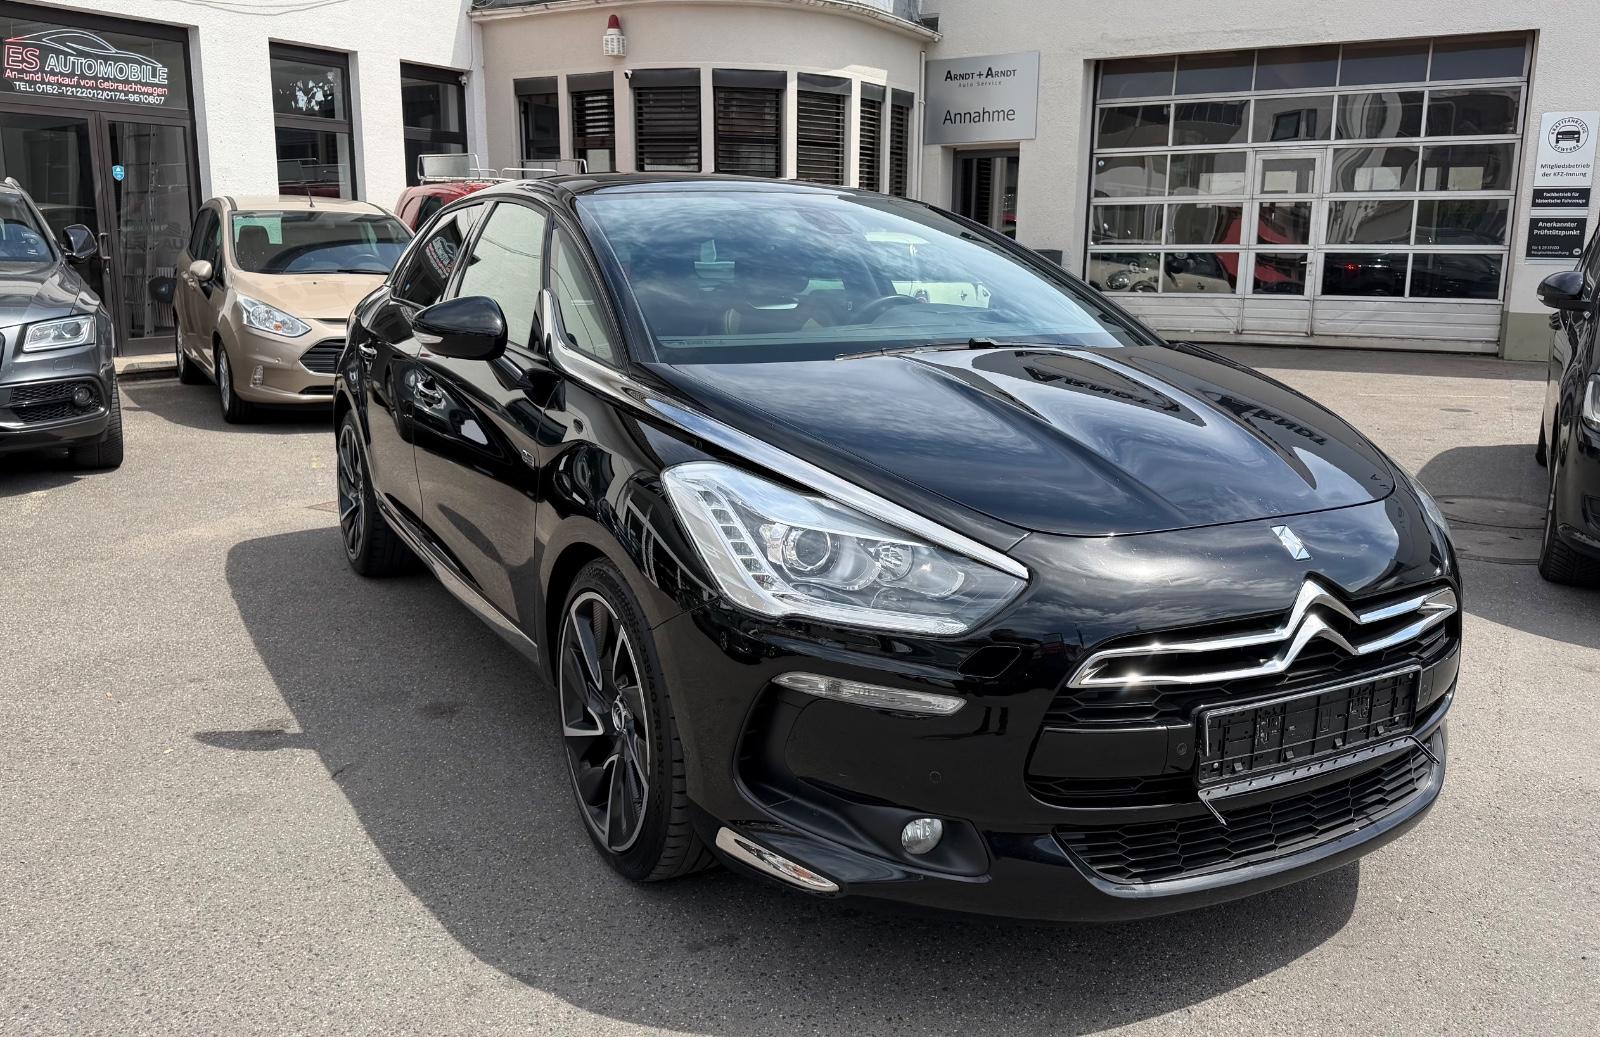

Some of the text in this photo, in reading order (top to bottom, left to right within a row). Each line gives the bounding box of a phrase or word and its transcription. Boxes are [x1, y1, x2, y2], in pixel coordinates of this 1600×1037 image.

[5, 45, 168, 84] ES AUTOMOBILE
[14, 81, 34, 91] TEL:
[43, 73, 78, 85] Verkauf
[98, 80, 168, 96] Gebrauchtwagen
[943, 107, 1016, 125] Annahme
